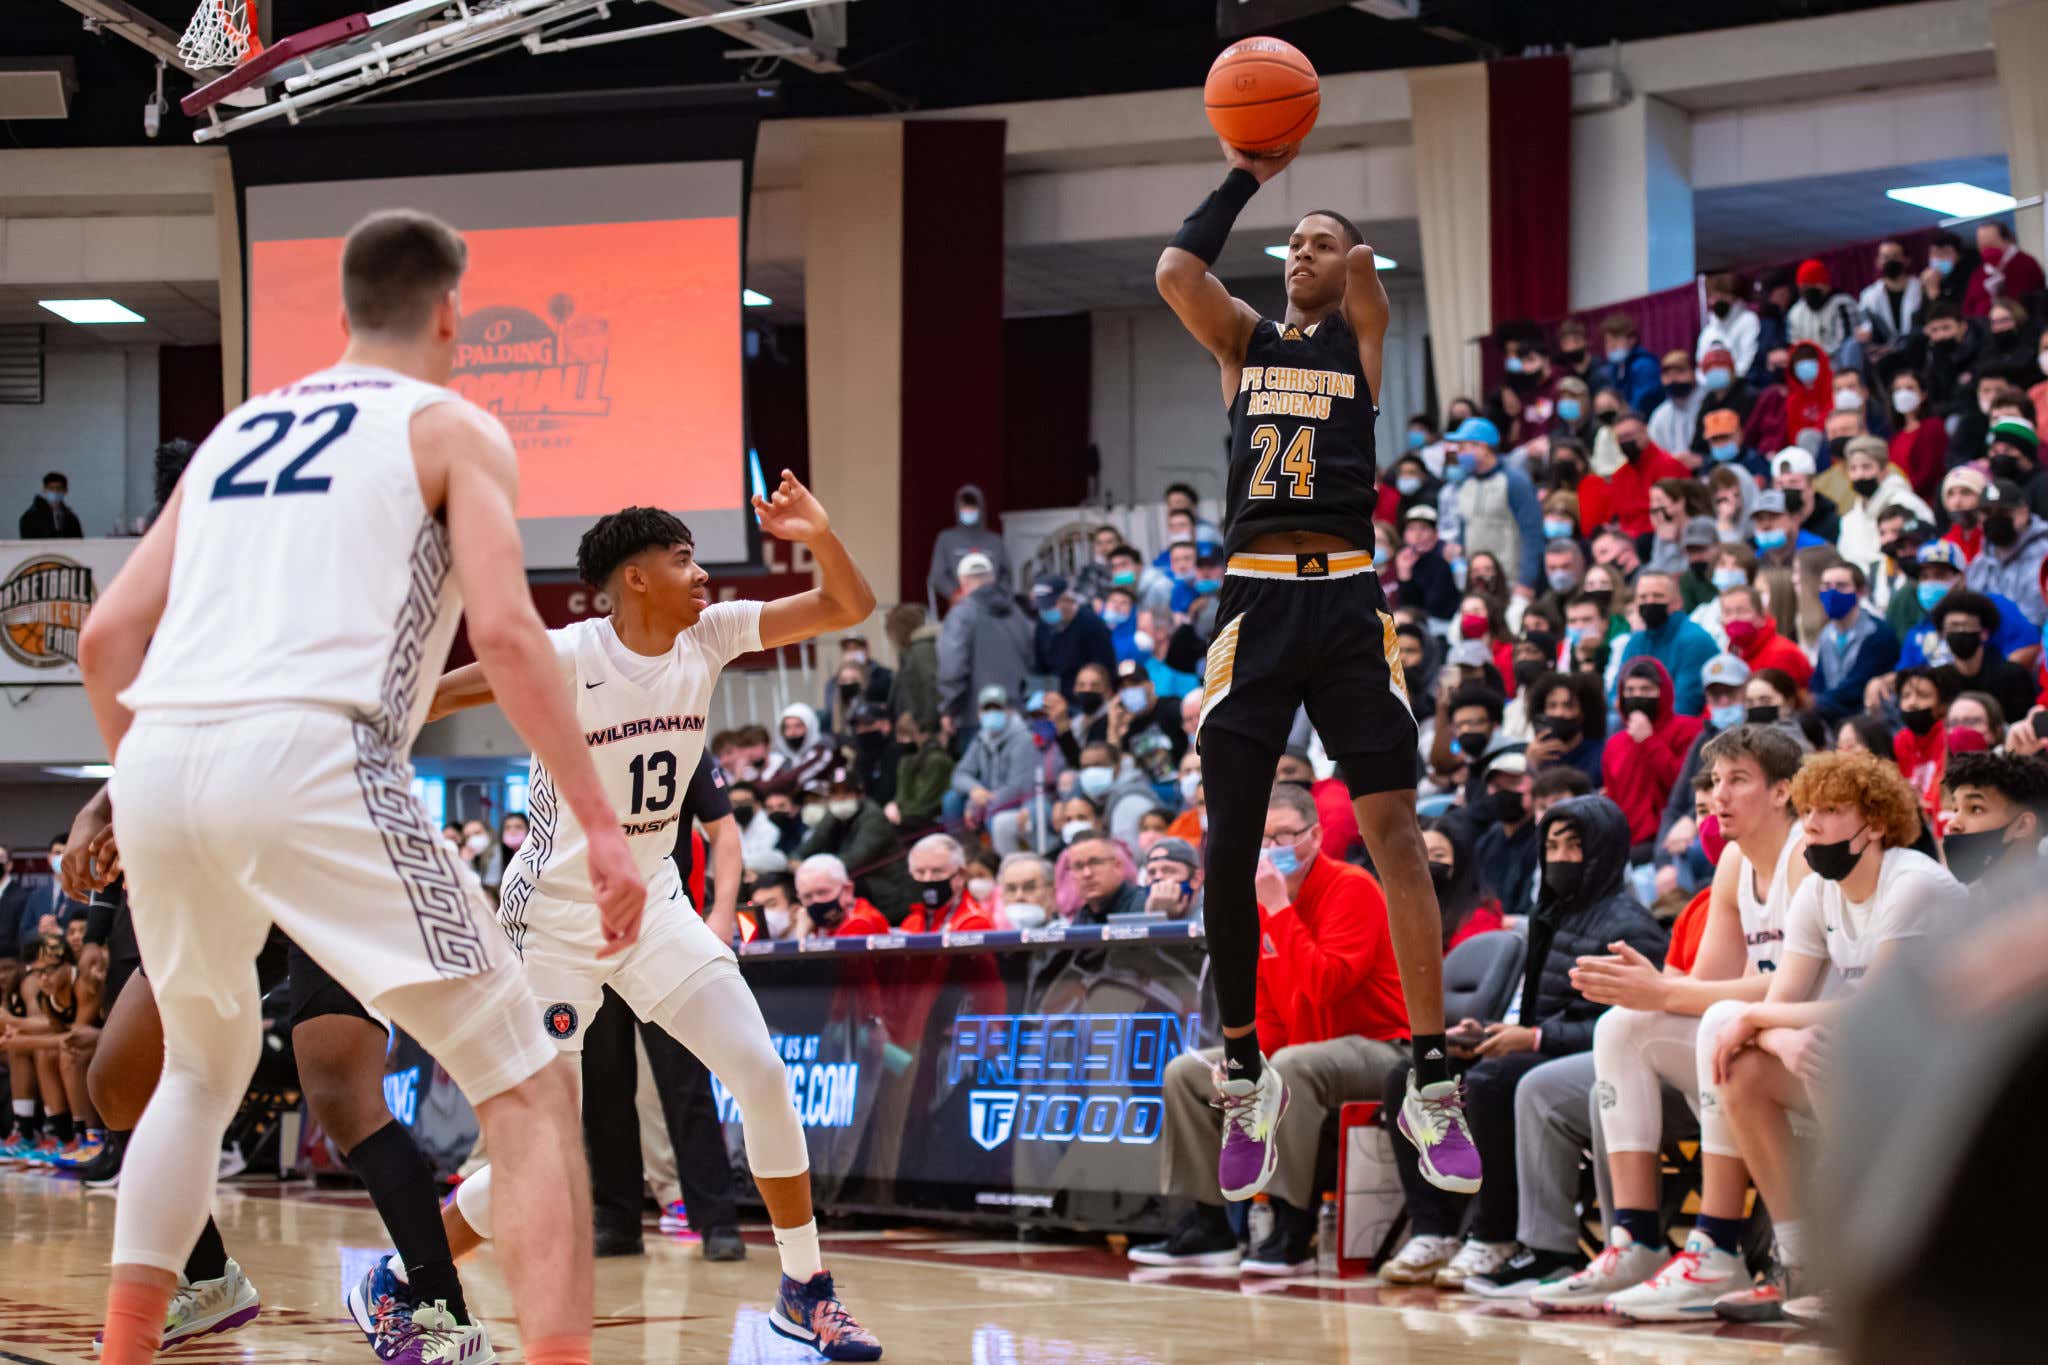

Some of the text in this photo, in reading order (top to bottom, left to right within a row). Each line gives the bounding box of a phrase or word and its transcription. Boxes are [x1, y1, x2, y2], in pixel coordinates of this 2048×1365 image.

[1247, 392, 1333, 420] ACADEMY
[1264, 366, 1355, 399] CHRISTIAN
[210, 401, 358, 501] 22
[1249, 424, 1316, 499] 24
[0, 567, 90, 611] ASKETBALL
[46, 624, 79, 662] FAM
[629, 750, 677, 815] 13
[783, 1035, 802, 1060] US
[803, 1035, 820, 1060] AT
[948, 1013, 1200, 1087] PRECISION
[1018, 1095, 1165, 1145] 1000
